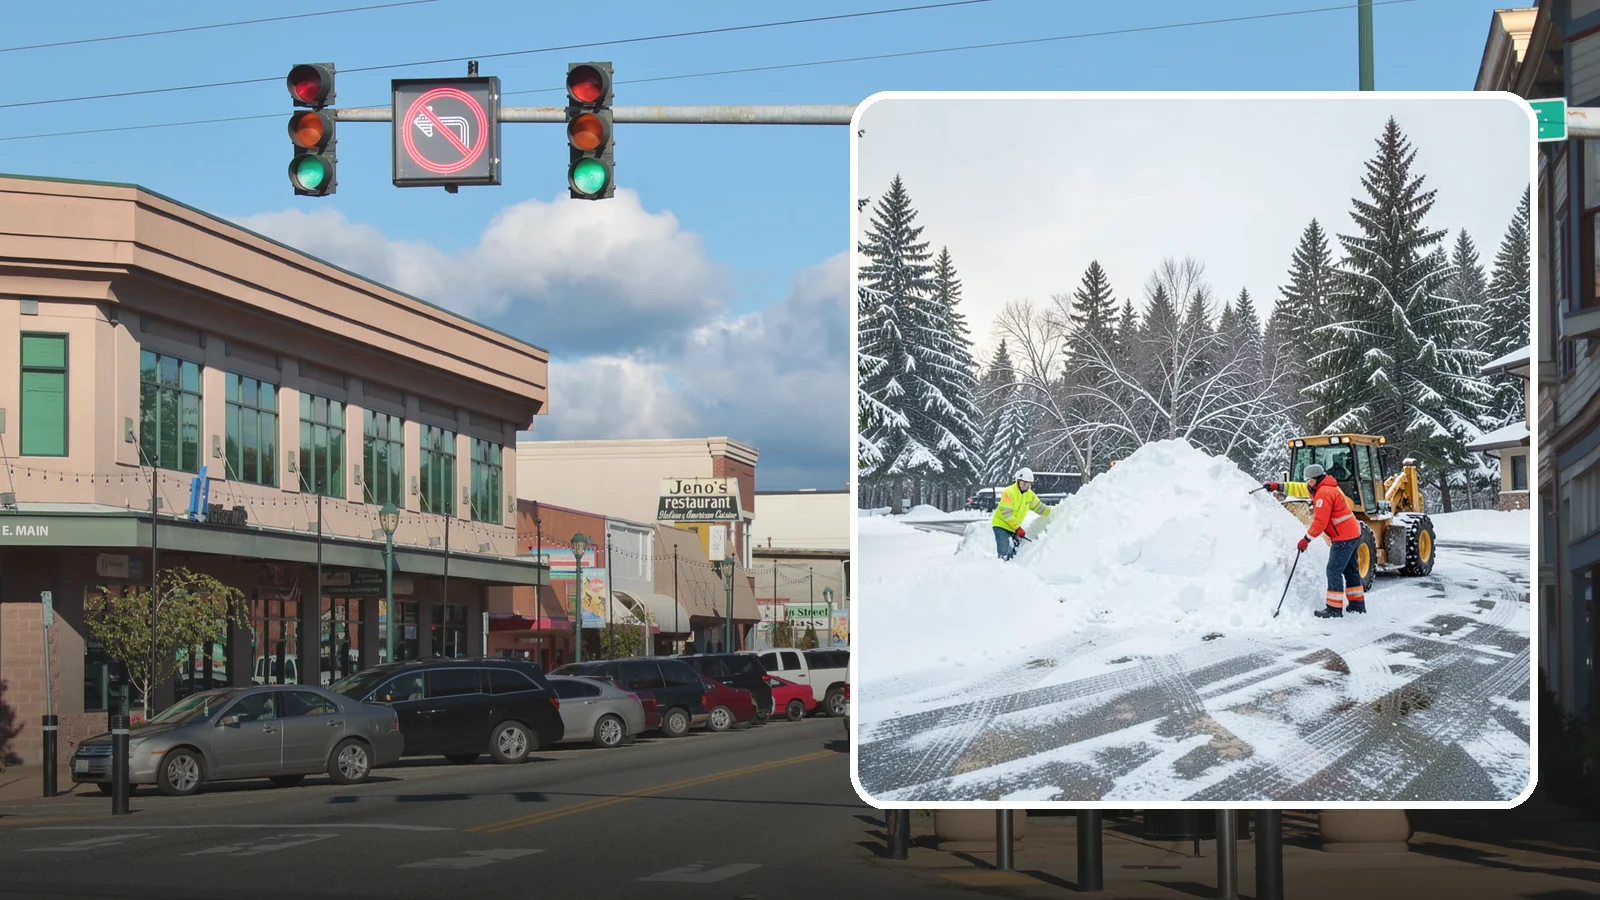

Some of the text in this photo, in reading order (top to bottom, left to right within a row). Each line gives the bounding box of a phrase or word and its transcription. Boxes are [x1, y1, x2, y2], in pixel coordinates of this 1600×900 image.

[669, 480, 728, 495] Jeno's
[665, 495, 731, 509] restaurant
[686, 509, 715, 520] American
[714, 509, 738, 520] Cuisine
[2, 525, 49, 536] E. MAIN
[797, 607, 829, 617] Street
